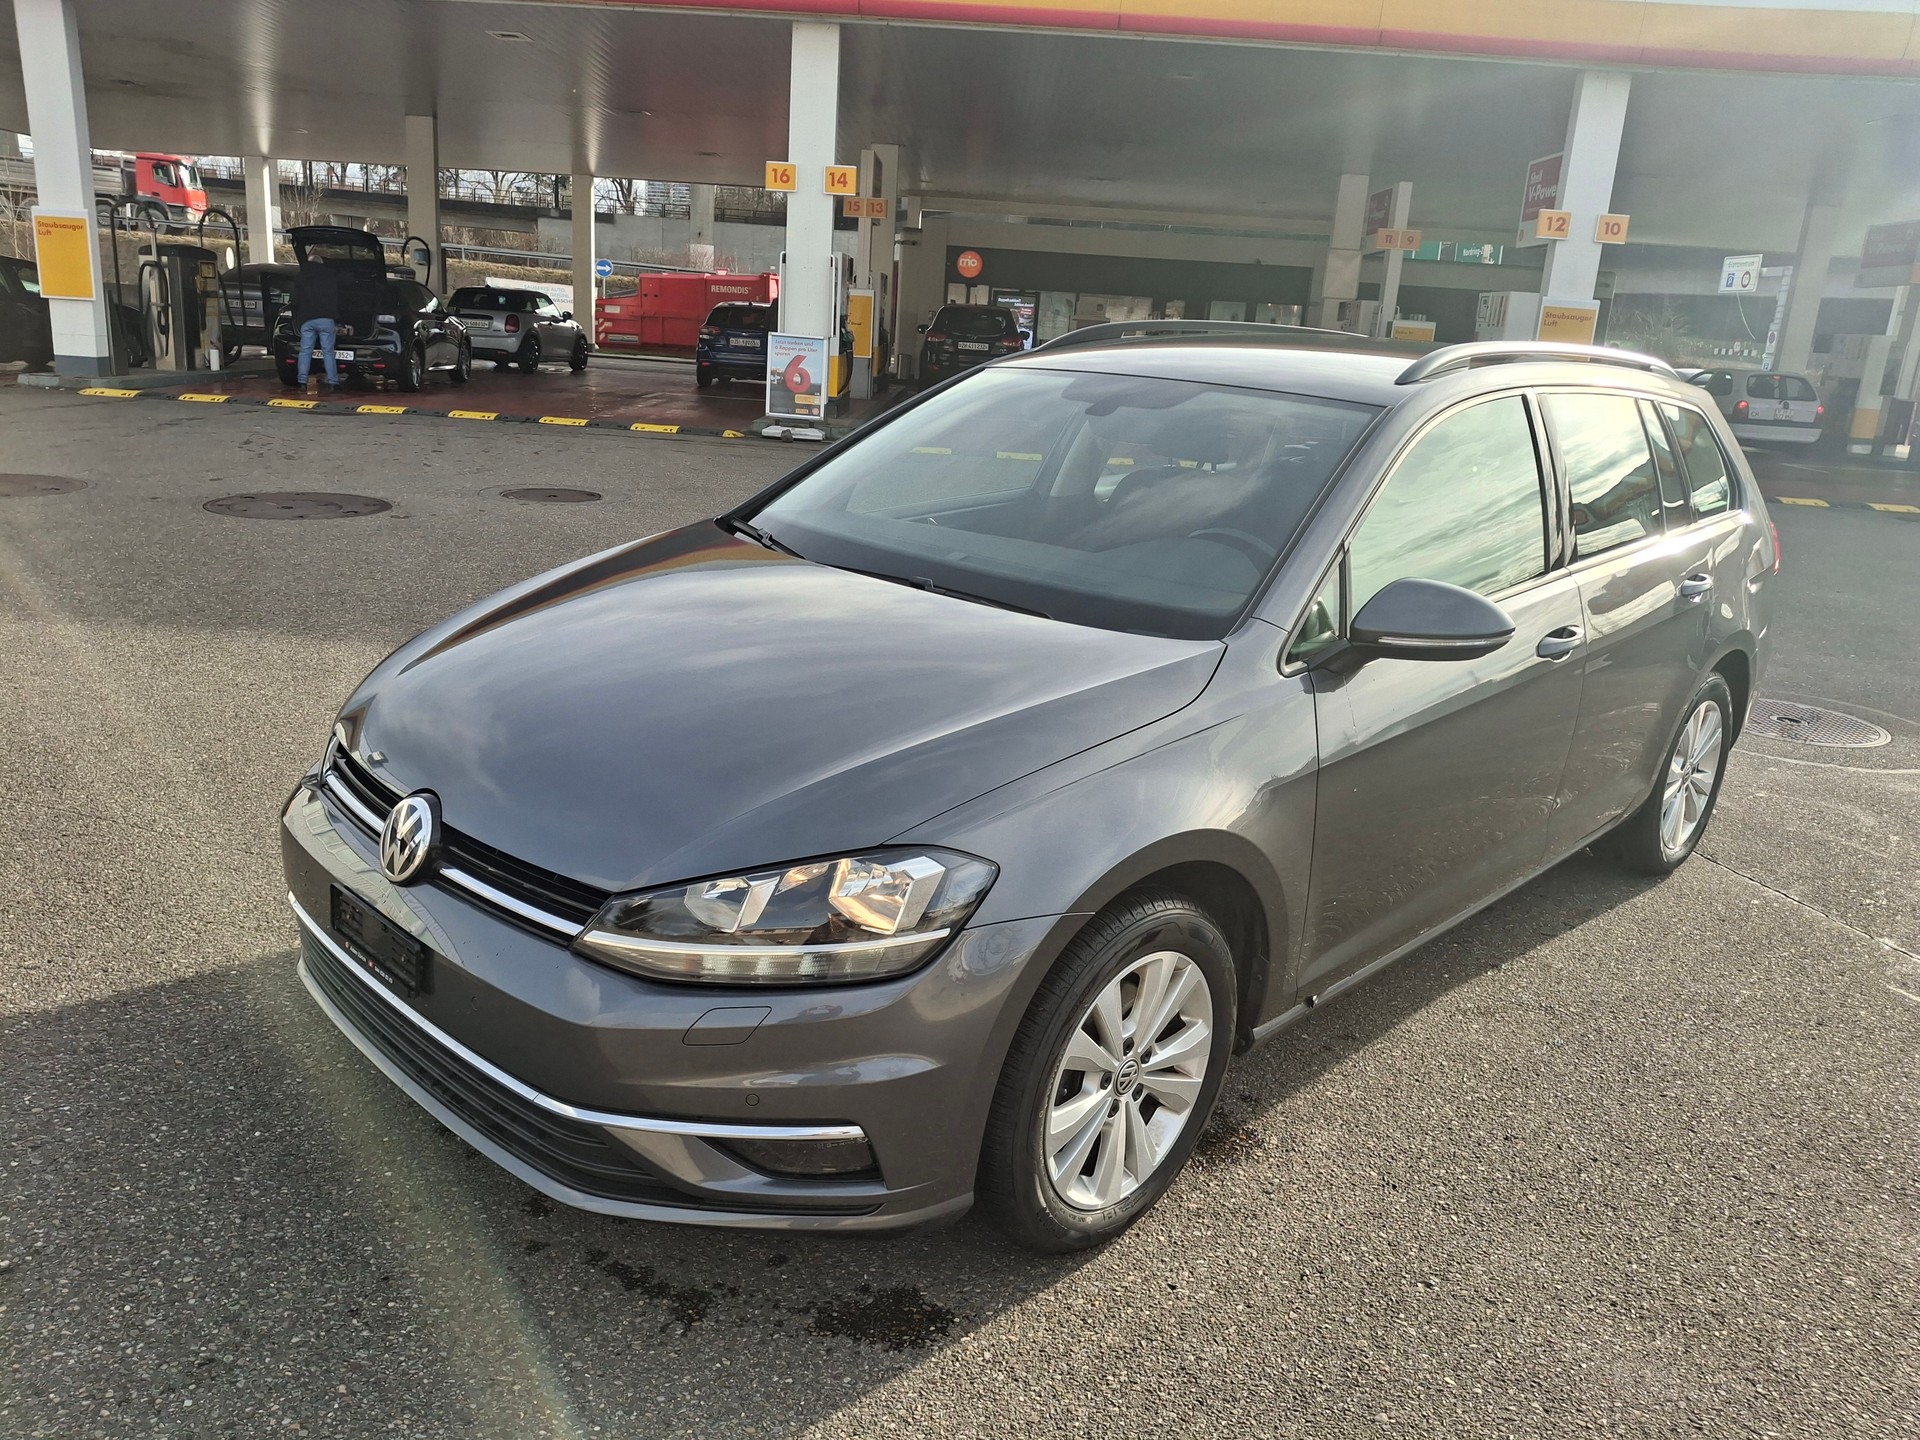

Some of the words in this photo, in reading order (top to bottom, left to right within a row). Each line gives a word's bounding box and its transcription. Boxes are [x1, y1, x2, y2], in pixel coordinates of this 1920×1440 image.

[771, 168, 790, 184] 16
[829, 172, 848, 188] 14
[1530, 169, 1543, 184] Shell
[1528, 185, 1557, 202] V-Powe
[848, 201, 860, 212] 15
[870, 202, 883, 214] 13
[37, 220, 83, 231] Staubsauger
[1547, 216, 1567, 232] 12
[1604, 222, 1621, 236] 10
[1385, 235, 1393, 244] 11
[1407, 236, 1414, 244] 9
[711, 284, 750, 295] REMONDIS
[1543, 319, 1558, 327] Luft
[1545, 312, 1593, 322] Staubsauger
[784, 354, 811, 393] 6
